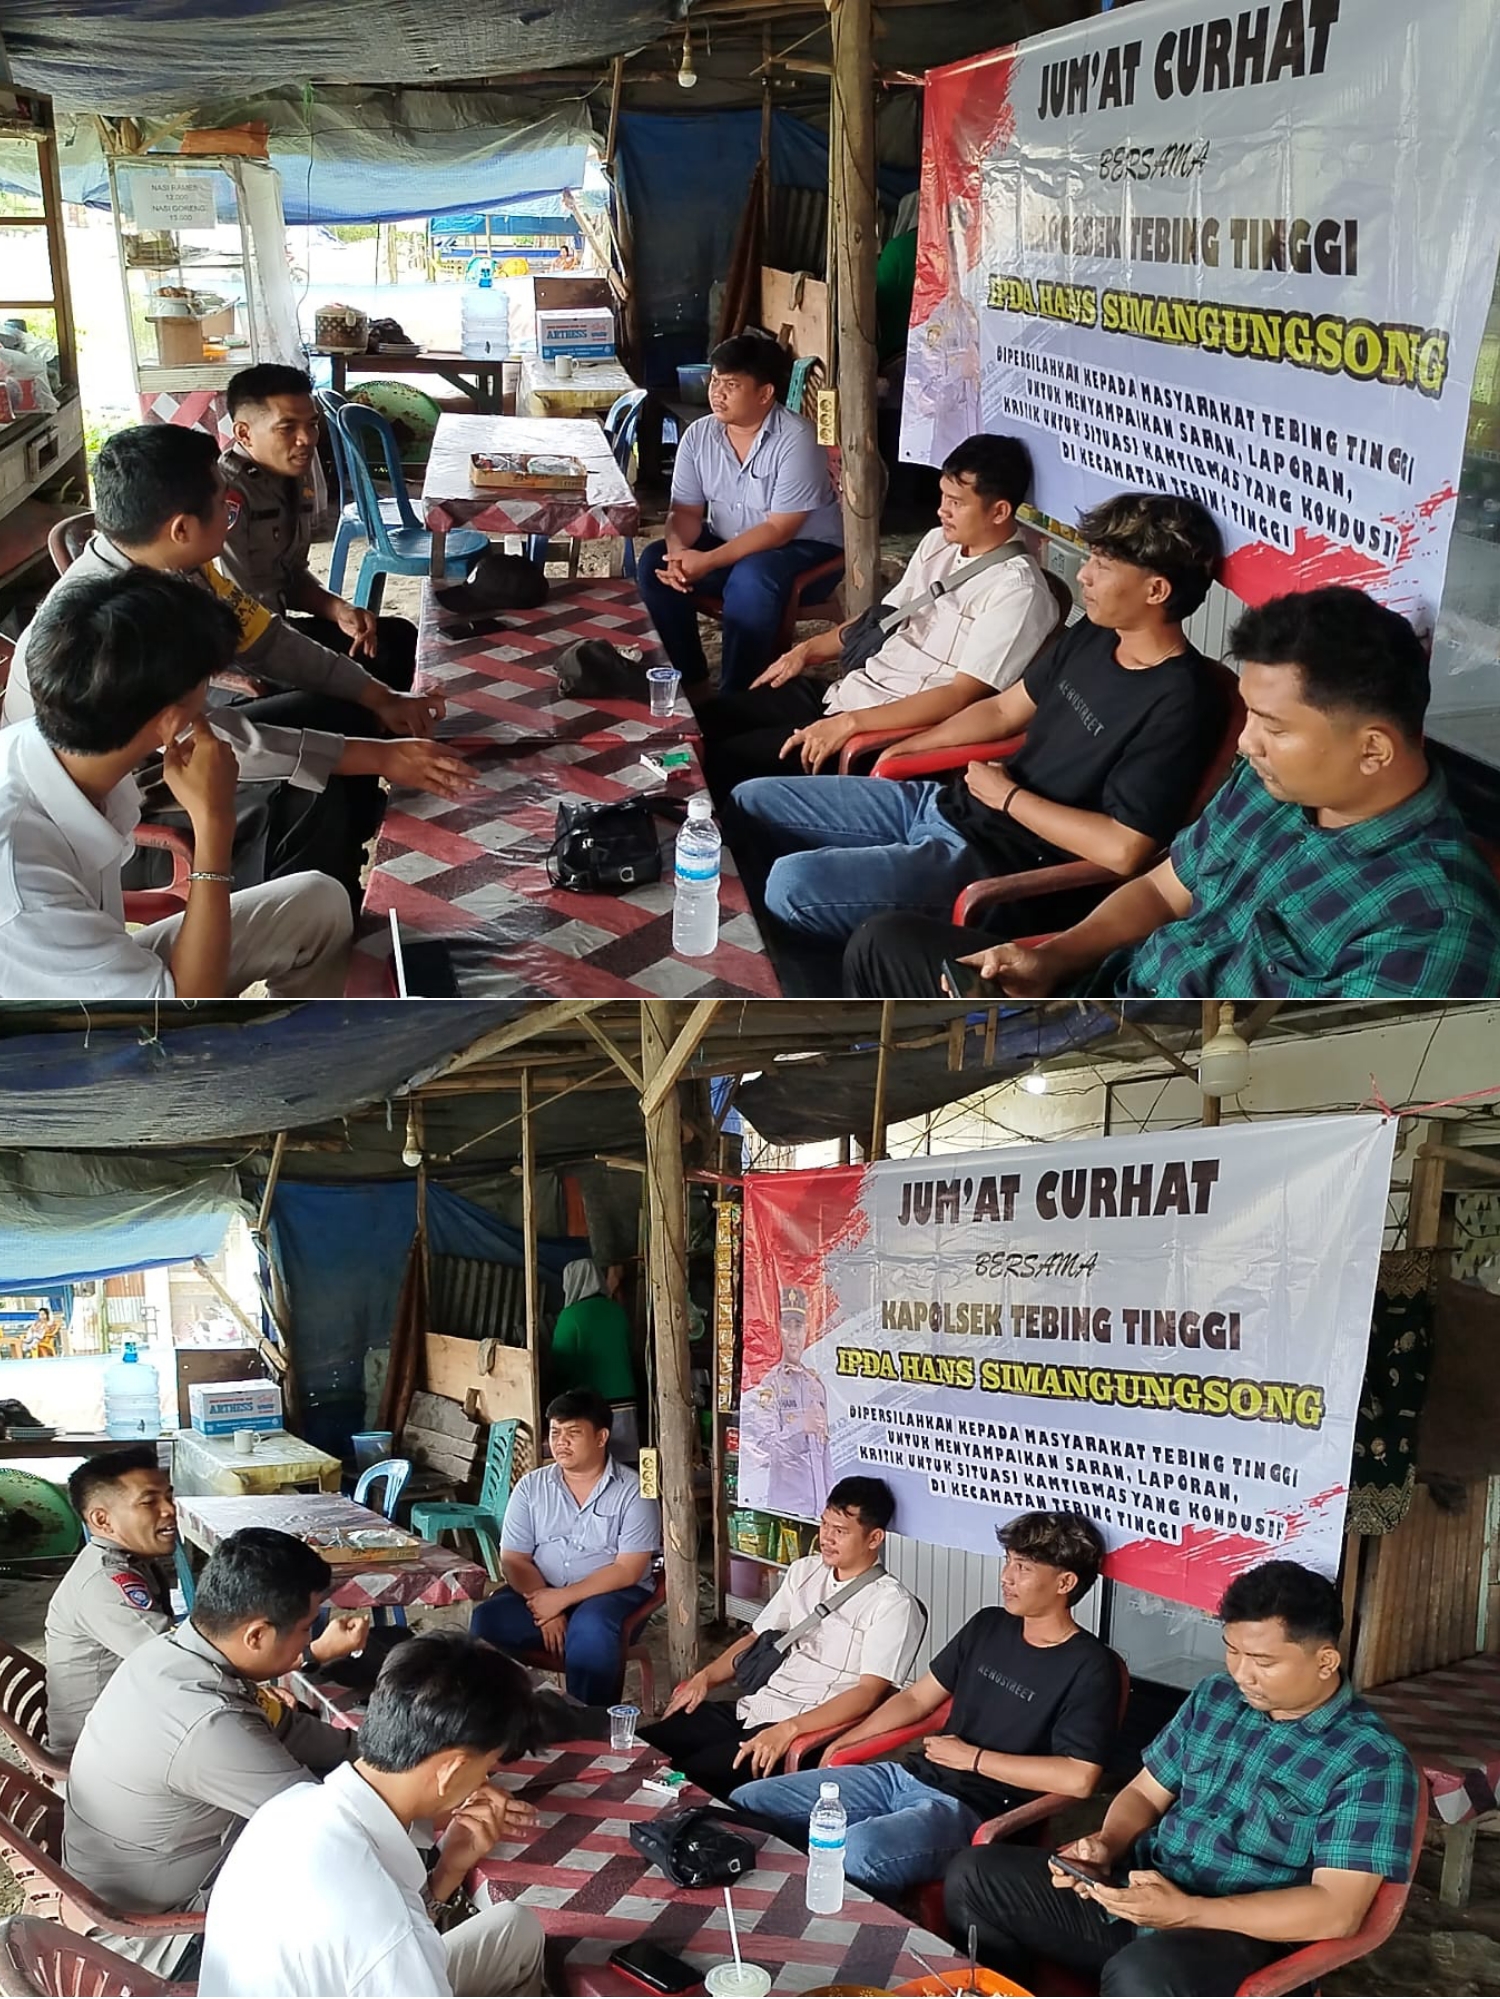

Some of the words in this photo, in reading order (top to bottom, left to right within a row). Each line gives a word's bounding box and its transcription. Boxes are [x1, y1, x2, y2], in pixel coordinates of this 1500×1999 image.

[1037, 40, 1143, 121] JUM'AT
[1154, 0, 1340, 100] CURHAT
[1099, 140, 1212, 182] BERSAMA
[1028, 215, 1123, 259] POLSEK
[1131, 217, 1221, 268] TEBING
[1230, 218, 1358, 276] TINGGI
[987, 273, 1039, 315] IPDA
[1037, 279, 1098, 328] HANS
[1101, 289, 1449, 399] SIMANGUNGSONG
[997, 345, 1080, 384] DIPERSILAHKAN
[1084, 367, 1137, 399] KEPADA
[1141, 382, 1255, 433] MASYARAKAT
[1262, 412, 1338, 456] TEBING
[1346, 434, 1415, 485] TINGGI
[1027, 378, 1061, 404] UNTUK
[1065, 389, 1174, 440] MENYAMPAIKAN
[1180, 423, 1242, 465] SARAN,
[1248, 444, 1353, 504] LAPORAN,
[1043, 409, 1080, 436] UNTUK
[1084, 423, 1138, 456] SITUASI
[1143, 440, 1240, 491] KAMTIBMAS
[1243, 473, 1292, 514] YANG
[1062, 441, 1076, 462] DI
[1080, 446, 1167, 492] KECAMATAN
[1231, 500, 1290, 547] TINGGI
[898, 1173, 1021, 1226] JUM'AT
[1036, 1159, 1221, 1220] CURHAT
[975, 1251, 1099, 1279] BERSAMA
[881, 1300, 1003, 1337] KAPOLSEK
[1010, 1304, 1112, 1343] TEBING
[1122, 1308, 1241, 1351] TINGGI
[837, 1347, 898, 1379] IPDA
[899, 1353, 975, 1390] HANS
[980, 1358, 1325, 1430] SIMANGUNGSONG
[849, 1404, 952, 1433] DIPERSILAHKAN
[958, 1420, 1020, 1442] KEPADA
[1025, 1428, 1146, 1461] MASYARAKAT
[1152, 1446, 1225, 1473] TEBING
[1232, 1457, 1299, 1488] TINGGI
[887, 1430, 930, 1449] UNTUK
[935, 1438, 1058, 1470] MENYAMPAIKAN
[1065, 1457, 1132, 1484] SARAN,
[1137, 1468, 1239, 1504] LAPORAN,
[859, 1446, 904, 1466] KRITIK
[908, 1454, 951, 1475] UNTUK
[957, 1462, 1018, 1485] SITUASI
[1024, 1473, 1126, 1504] KAMTIBMAS
[1131, 1490, 1181, 1516] YANG
[1189, 1501, 1285, 1541] KONDUSIF
[931, 1478, 946, 1493] DI
[951, 1482, 1047, 1510] KECAMATAN
[1052, 1498, 1112, 1524] TEBING
[1117, 1510, 1178, 1540] TINGGI
